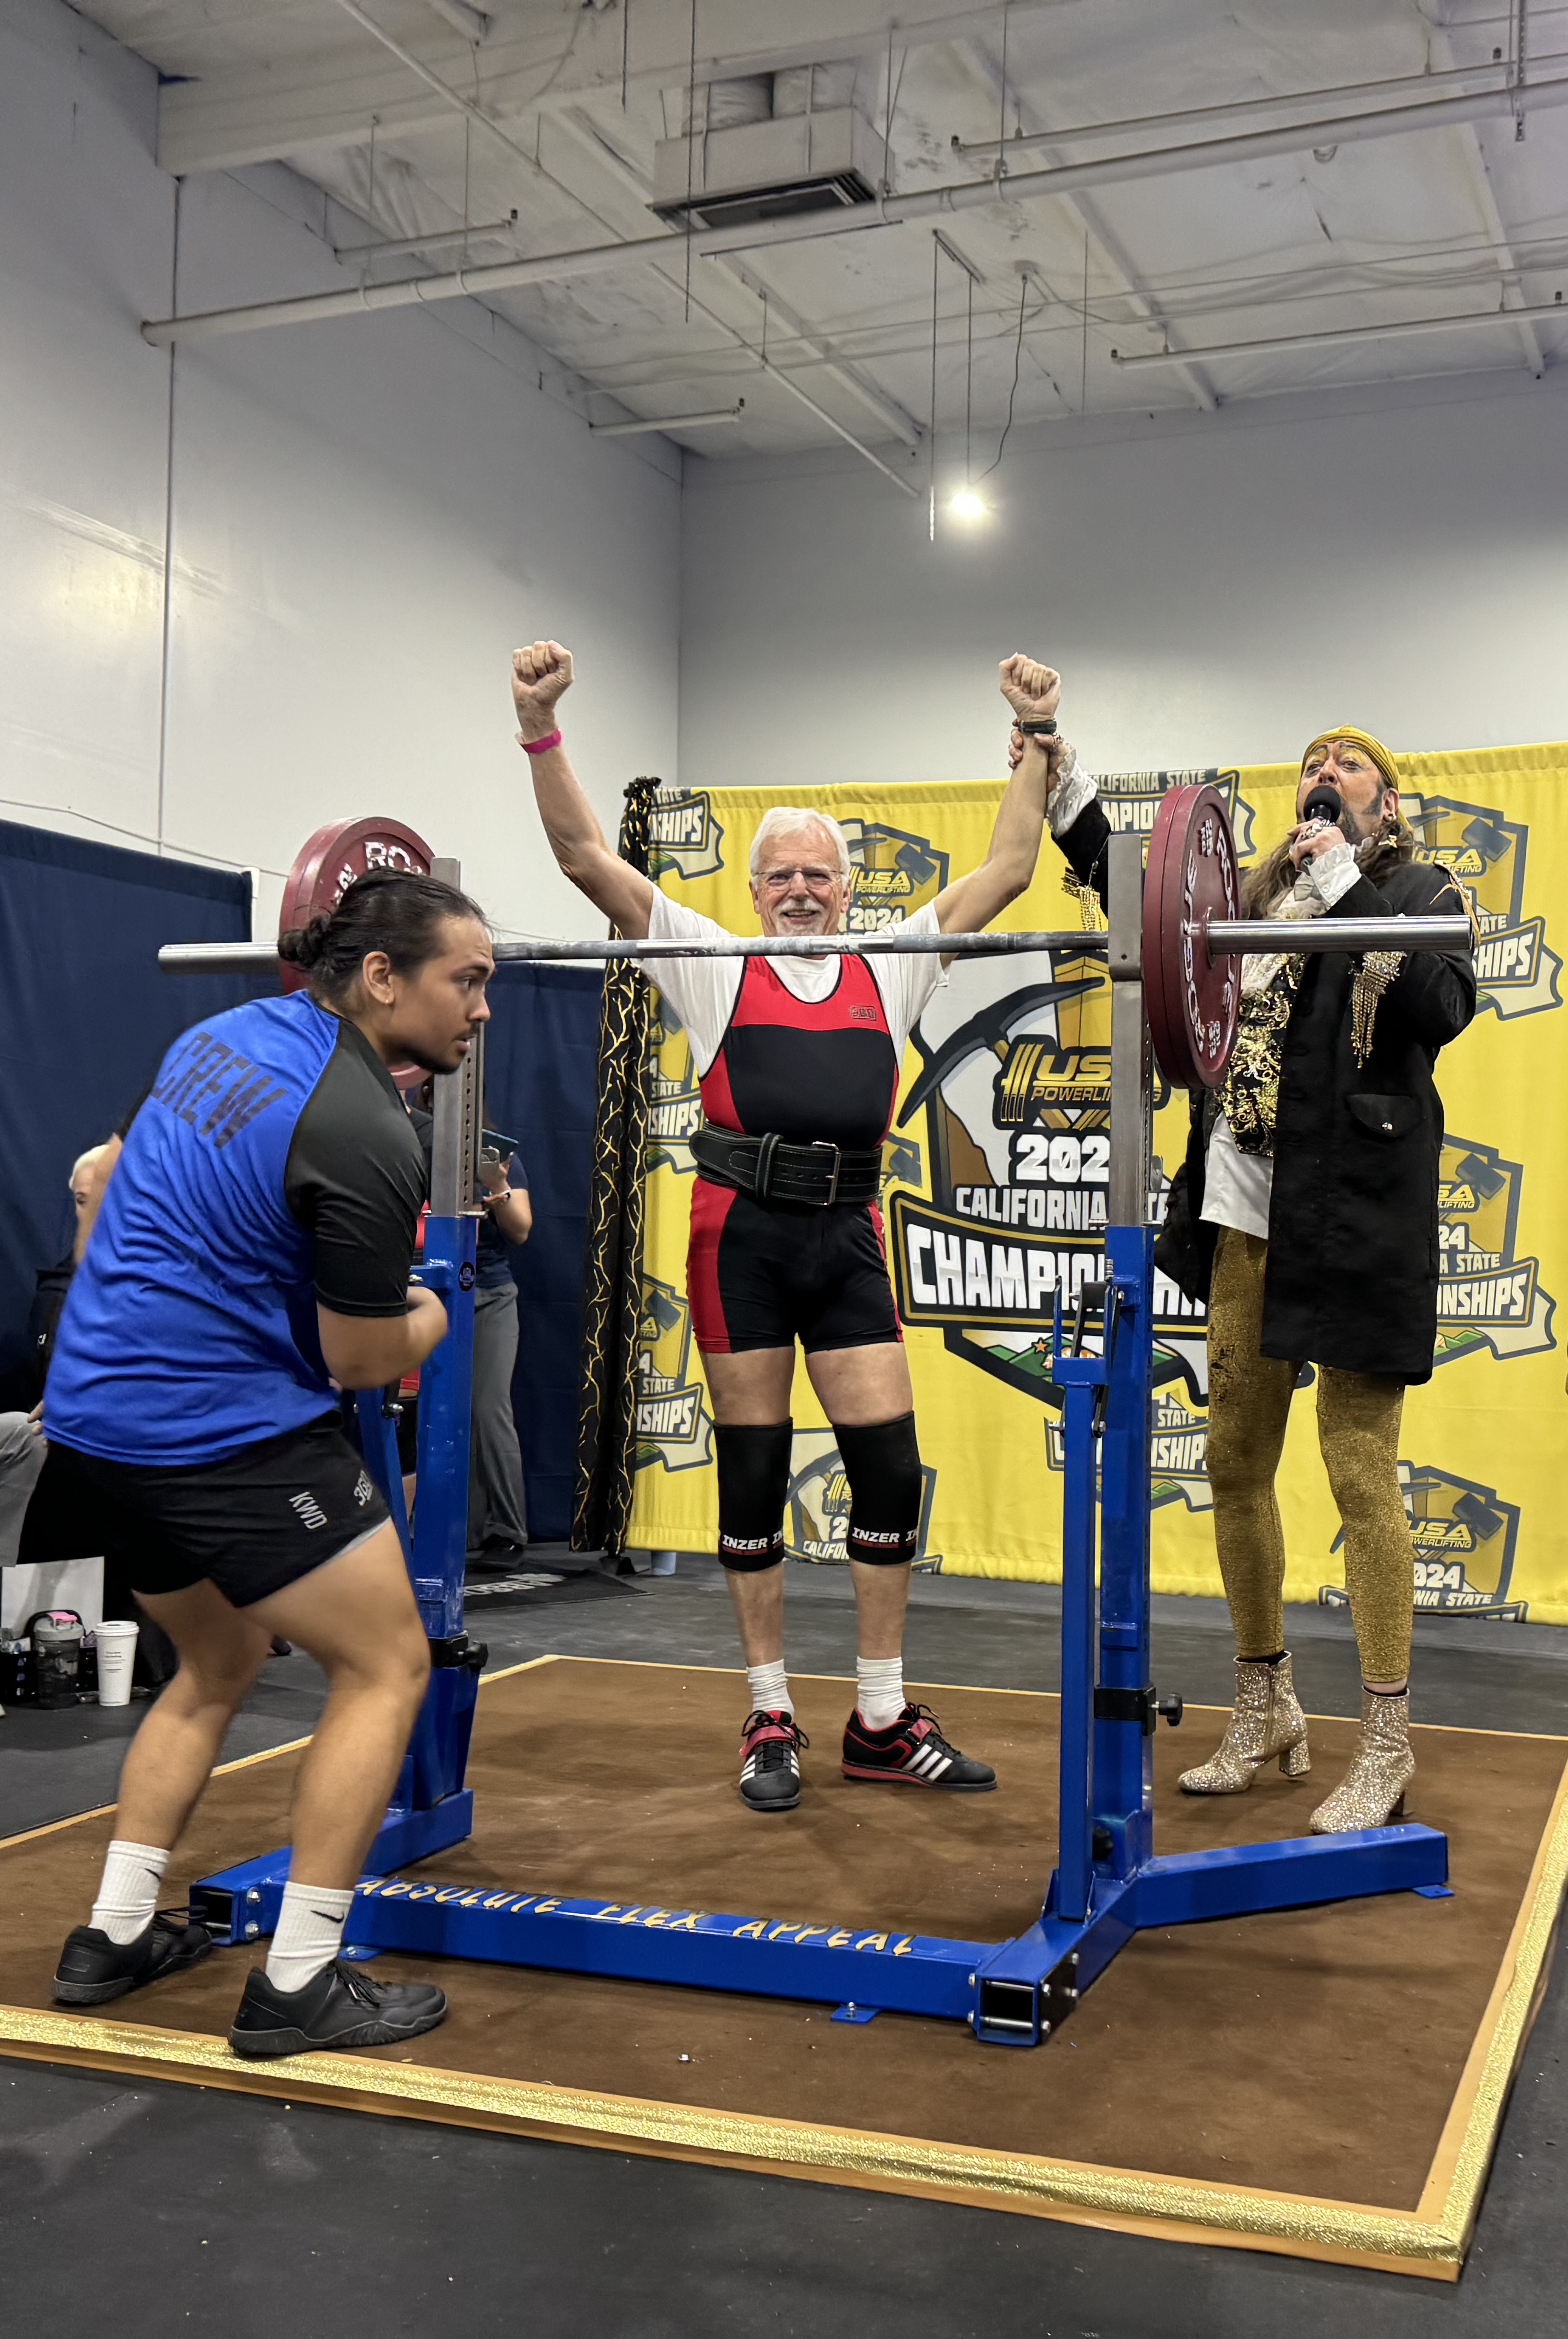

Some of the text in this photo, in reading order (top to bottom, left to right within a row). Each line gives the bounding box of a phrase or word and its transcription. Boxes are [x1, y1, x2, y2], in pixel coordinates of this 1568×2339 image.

[1166, 769, 1206, 789] STATE
[1416, 849, 1482, 865] USA
[857, 871, 910, 885] USA
[849, 907, 903, 930] 2024
[1036, 1055, 1111, 1081] US
[151, 1032, 287, 1149] CREW
[1016, 1134, 1110, 1183] 202
[956, 1187, 1107, 1230] CALIFORNIA
[1438, 1225, 1466, 1250] 24
[1456, 1253, 1500, 1274] STATE
[642, 1378, 675, 1394] STATE
[1157, 1409, 1196, 1427] STATE
[289, 1491, 328, 1529] KWD
[852, 1527, 900, 1543] INZER
[1408, 1520, 1472, 1540] USA
[723, 1534, 768, 1550] INZER
[1414, 1562, 1461, 1589] 024
[1446, 1592, 1493, 1606] STATE
[355, 1877, 563, 1914] ABSOLUTE
[732, 1918, 916, 1956] APPEAL
